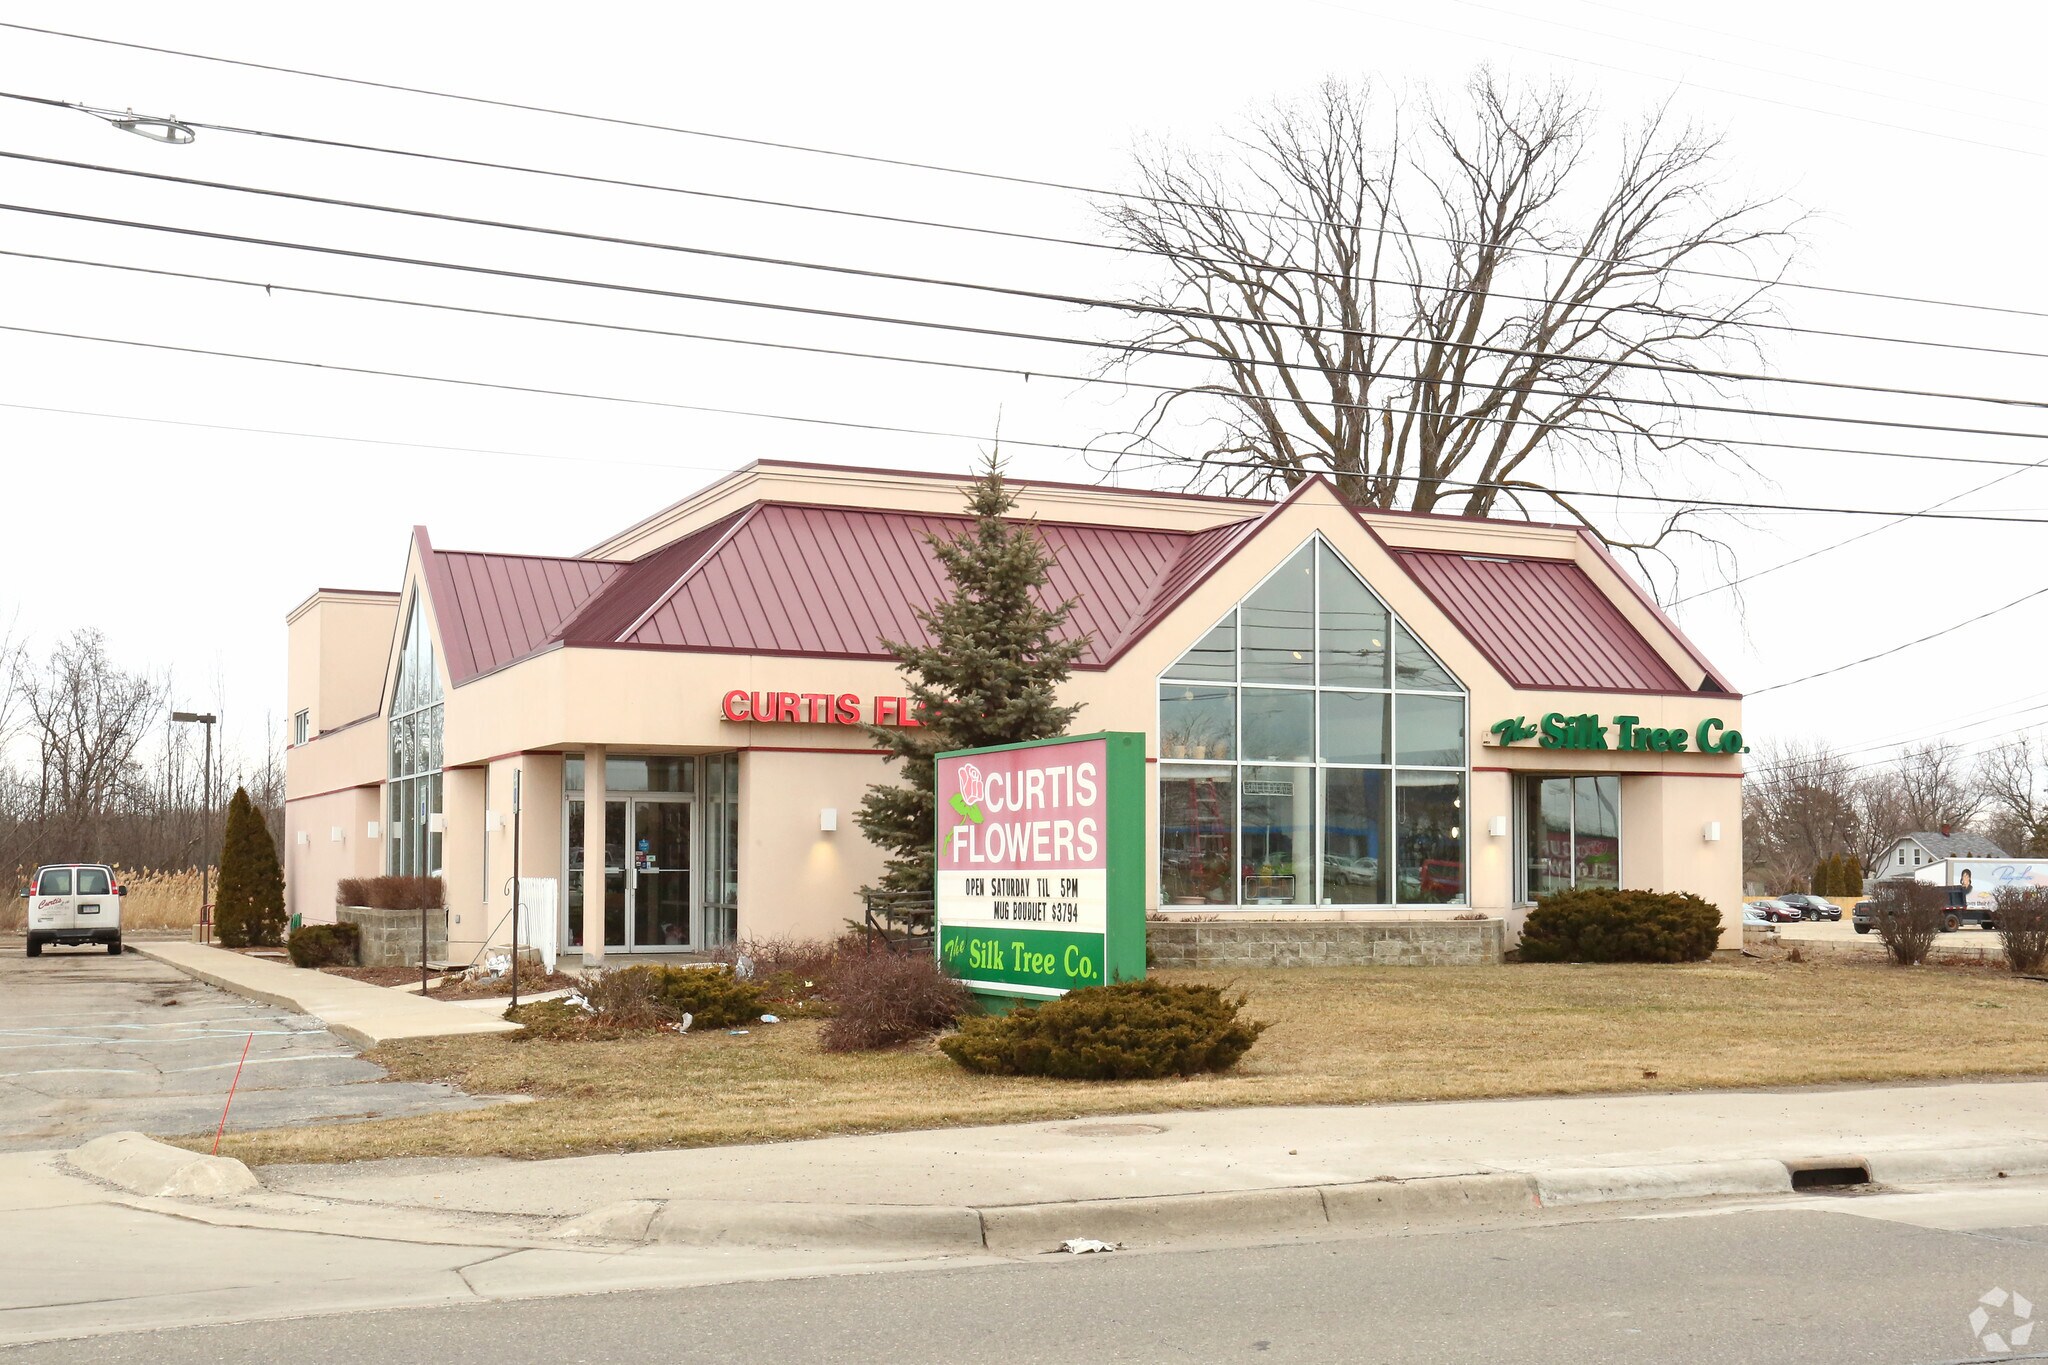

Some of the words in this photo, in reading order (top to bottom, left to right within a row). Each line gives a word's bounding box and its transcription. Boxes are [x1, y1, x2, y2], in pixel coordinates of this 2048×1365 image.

[722, 689, 861, 725] CURTIS
[1490, 715, 1538, 746] The
[1539, 712, 1608, 751] Silk
[1613, 715, 1688, 753] Tree
[1696, 717, 1750, 754] Co.
[984, 762, 1097, 814] CURTIS
[953, 817, 1098, 864] FLOWERS
[38, 897, 62, 910] Curtis
[965, 878, 985, 896] OPEN
[991, 878, 1030, 897] SATURDAY
[1037, 878, 1050, 897] TIL
[1060, 878, 1078, 898] 5PM
[994, 901, 1009, 920] MUG
[1013, 901, 1047, 921] BOUQUET
[1052, 902, 1078, 923] $3794
[944, 935, 966, 962] The
[969, 938, 1004, 971] Silk
[1011, 941, 1055, 974] Tree
[1063, 944, 1098, 979] Co.
